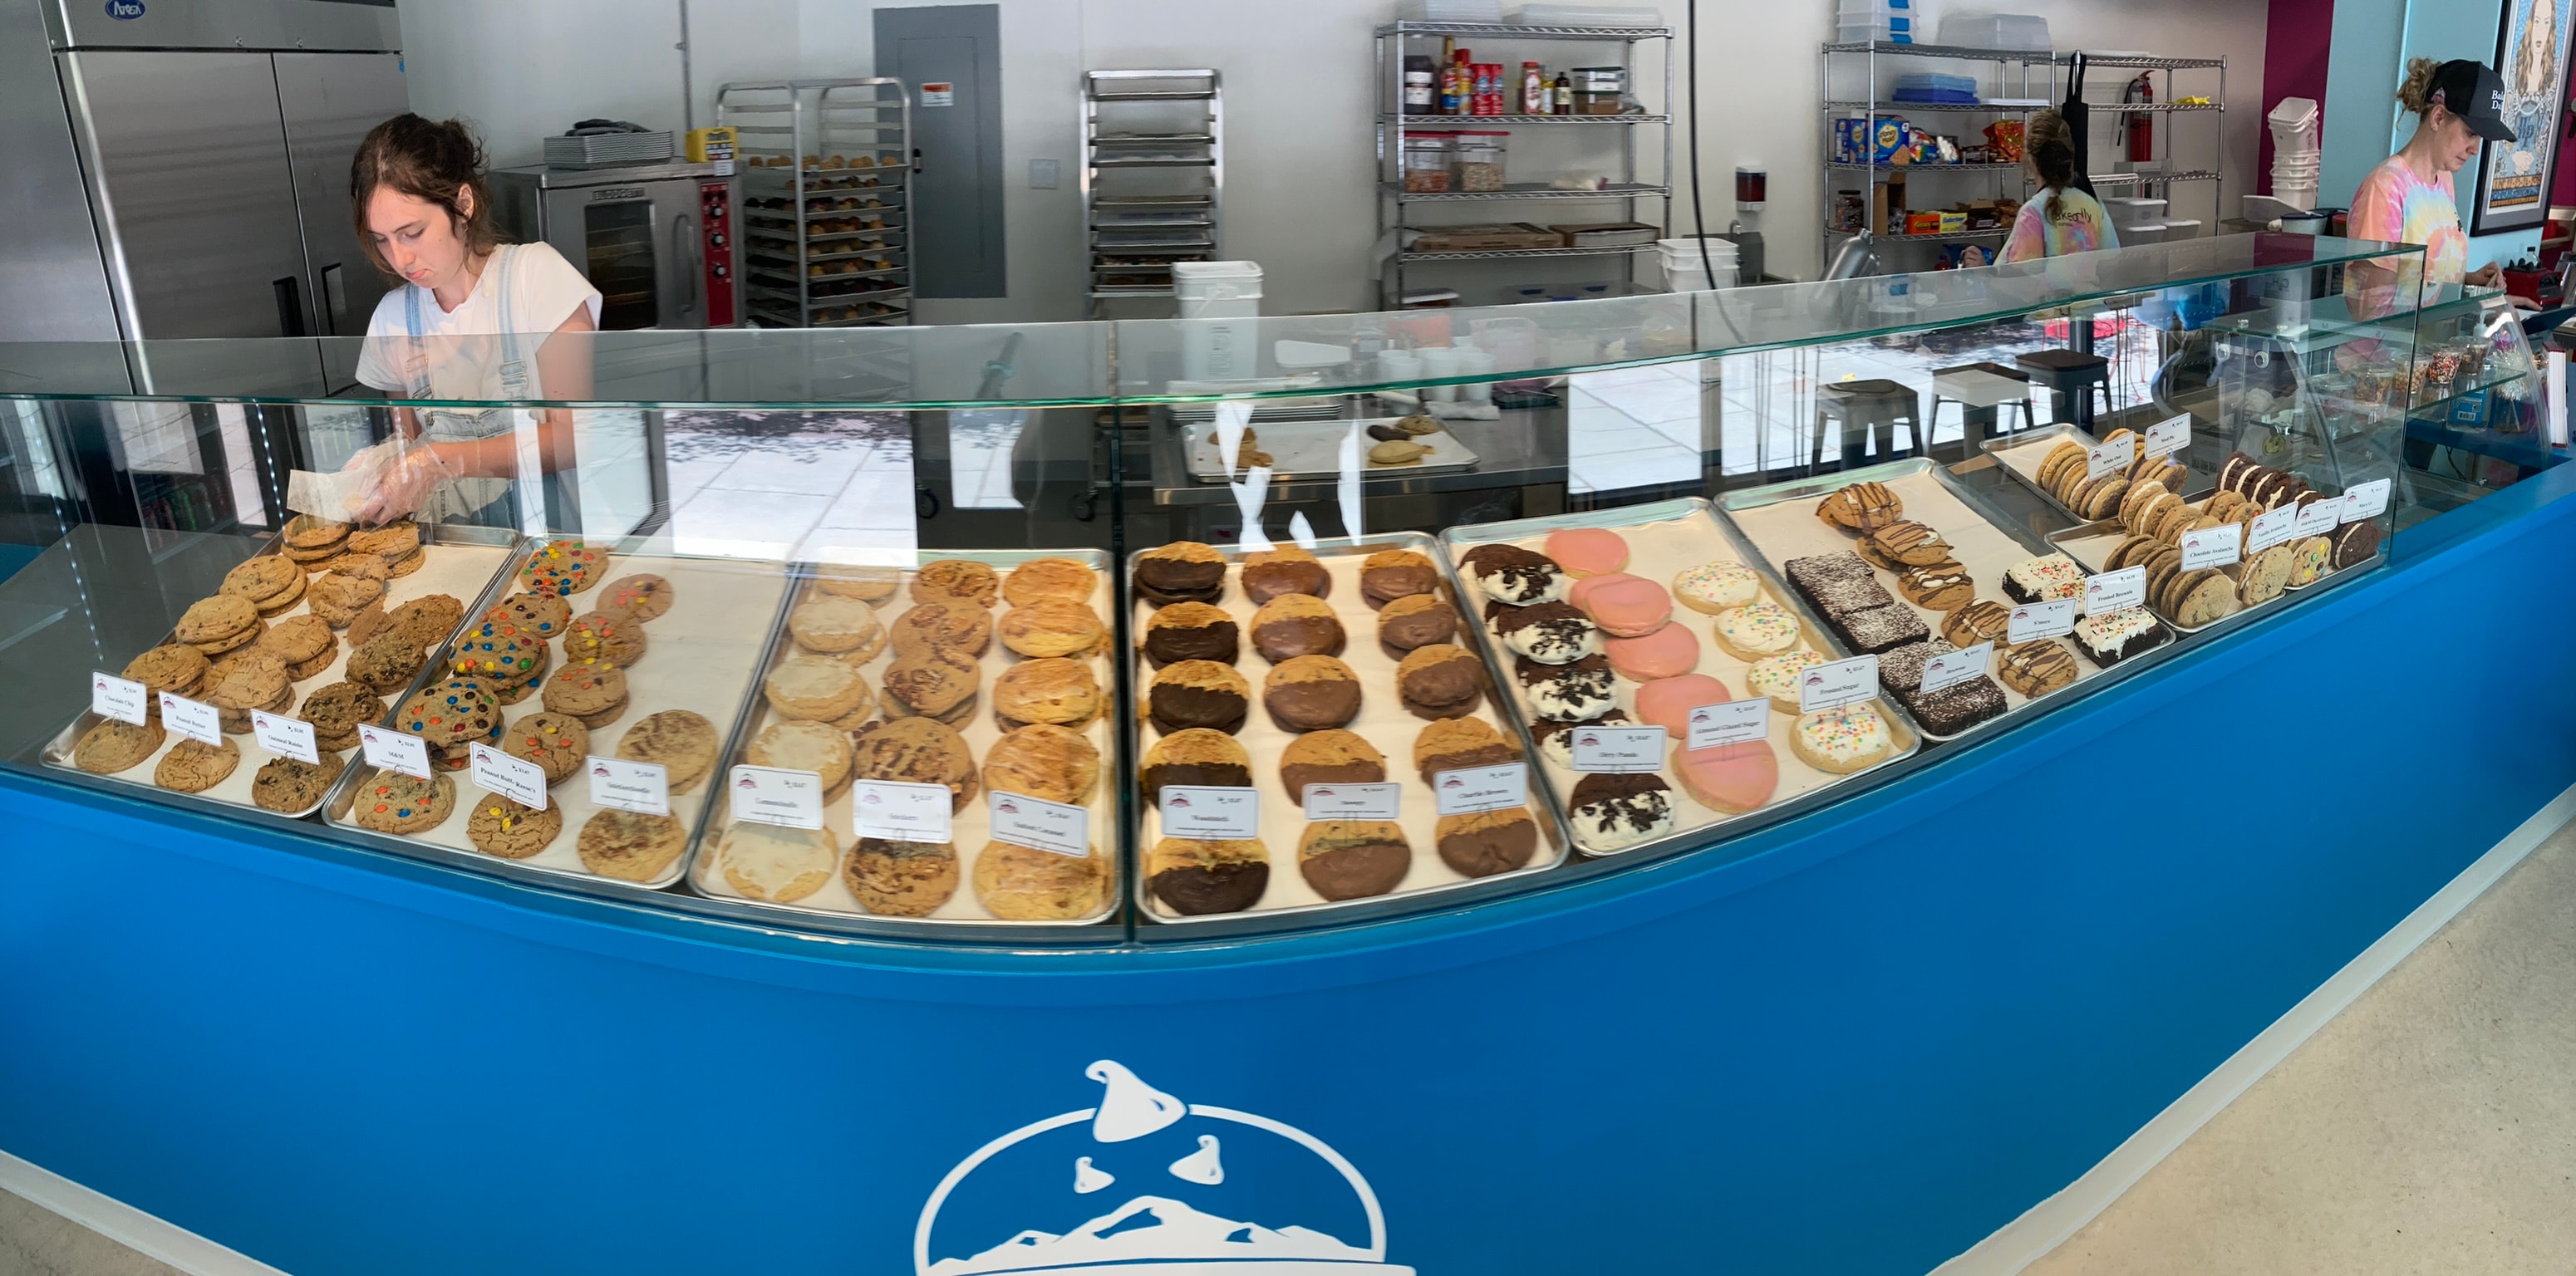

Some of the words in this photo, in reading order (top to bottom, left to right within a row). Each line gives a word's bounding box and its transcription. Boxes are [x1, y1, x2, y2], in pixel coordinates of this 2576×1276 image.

[2190, 549, 2211, 557] Chocolate
[2211, 546, 2234, 554] Avalanche
[2098, 593, 2115, 601] Frosted
[2115, 589, 2133, 597] Brownie
[176, 715, 192, 725] Peanut
[192, 719, 206, 729] Butter
[268, 734, 288, 745] Oatmeal
[288, 739, 303, 749] Raisin
[388, 751, 405, 760] M&M
[480, 768, 499, 780] Peanut
[515, 781, 536, 793] Reese's
